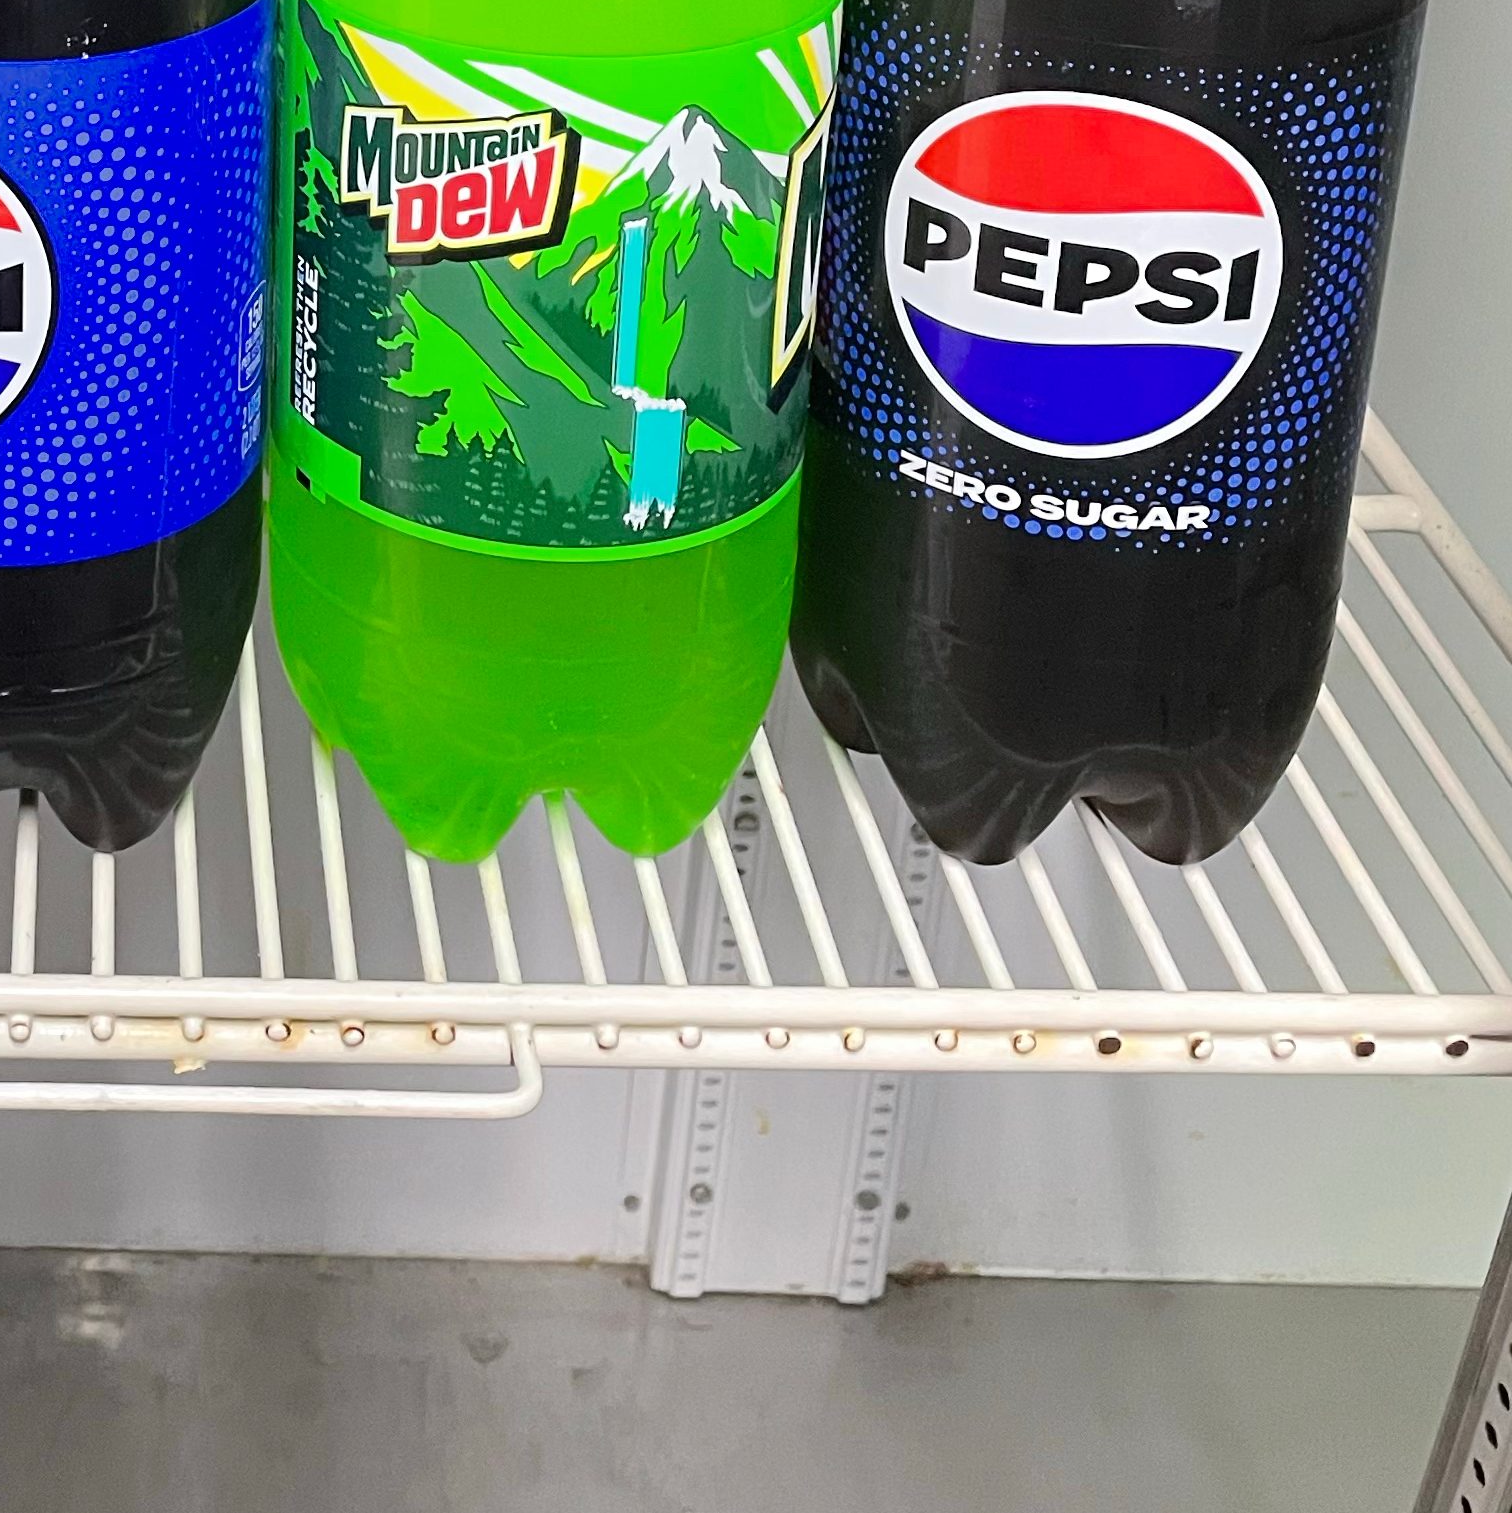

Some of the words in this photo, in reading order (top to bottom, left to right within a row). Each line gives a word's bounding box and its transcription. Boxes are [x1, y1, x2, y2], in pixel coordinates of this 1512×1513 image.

[902, 196, 1261, 326] PEPSI
[302, 260, 320, 426] RECYCLE
[899, 449, 1022, 512] ZERO
[1029, 490, 1211, 532] SUGAR
